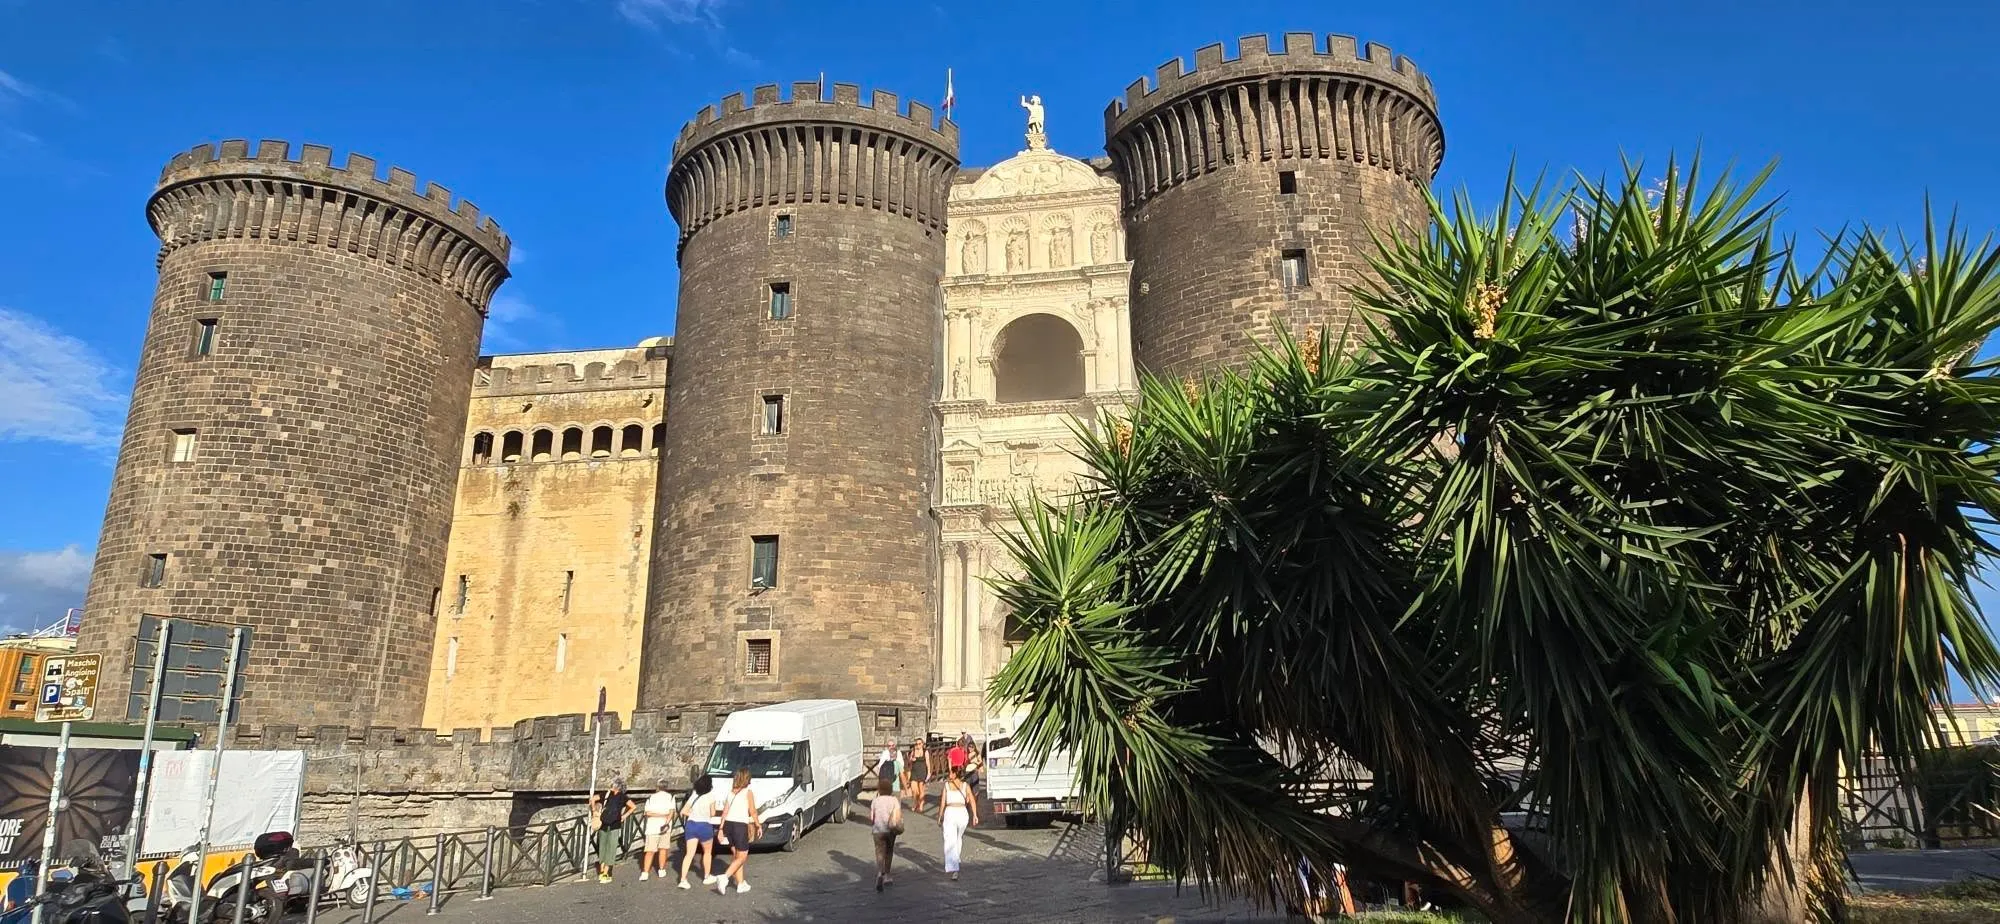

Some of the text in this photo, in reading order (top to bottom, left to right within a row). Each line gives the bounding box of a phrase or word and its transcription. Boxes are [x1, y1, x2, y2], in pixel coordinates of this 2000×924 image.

[67, 659, 97, 668] Maschio
[64, 668, 96, 677] Angioino
[46, 686, 57, 701] P
[0, 818, 25, 836] ORE
